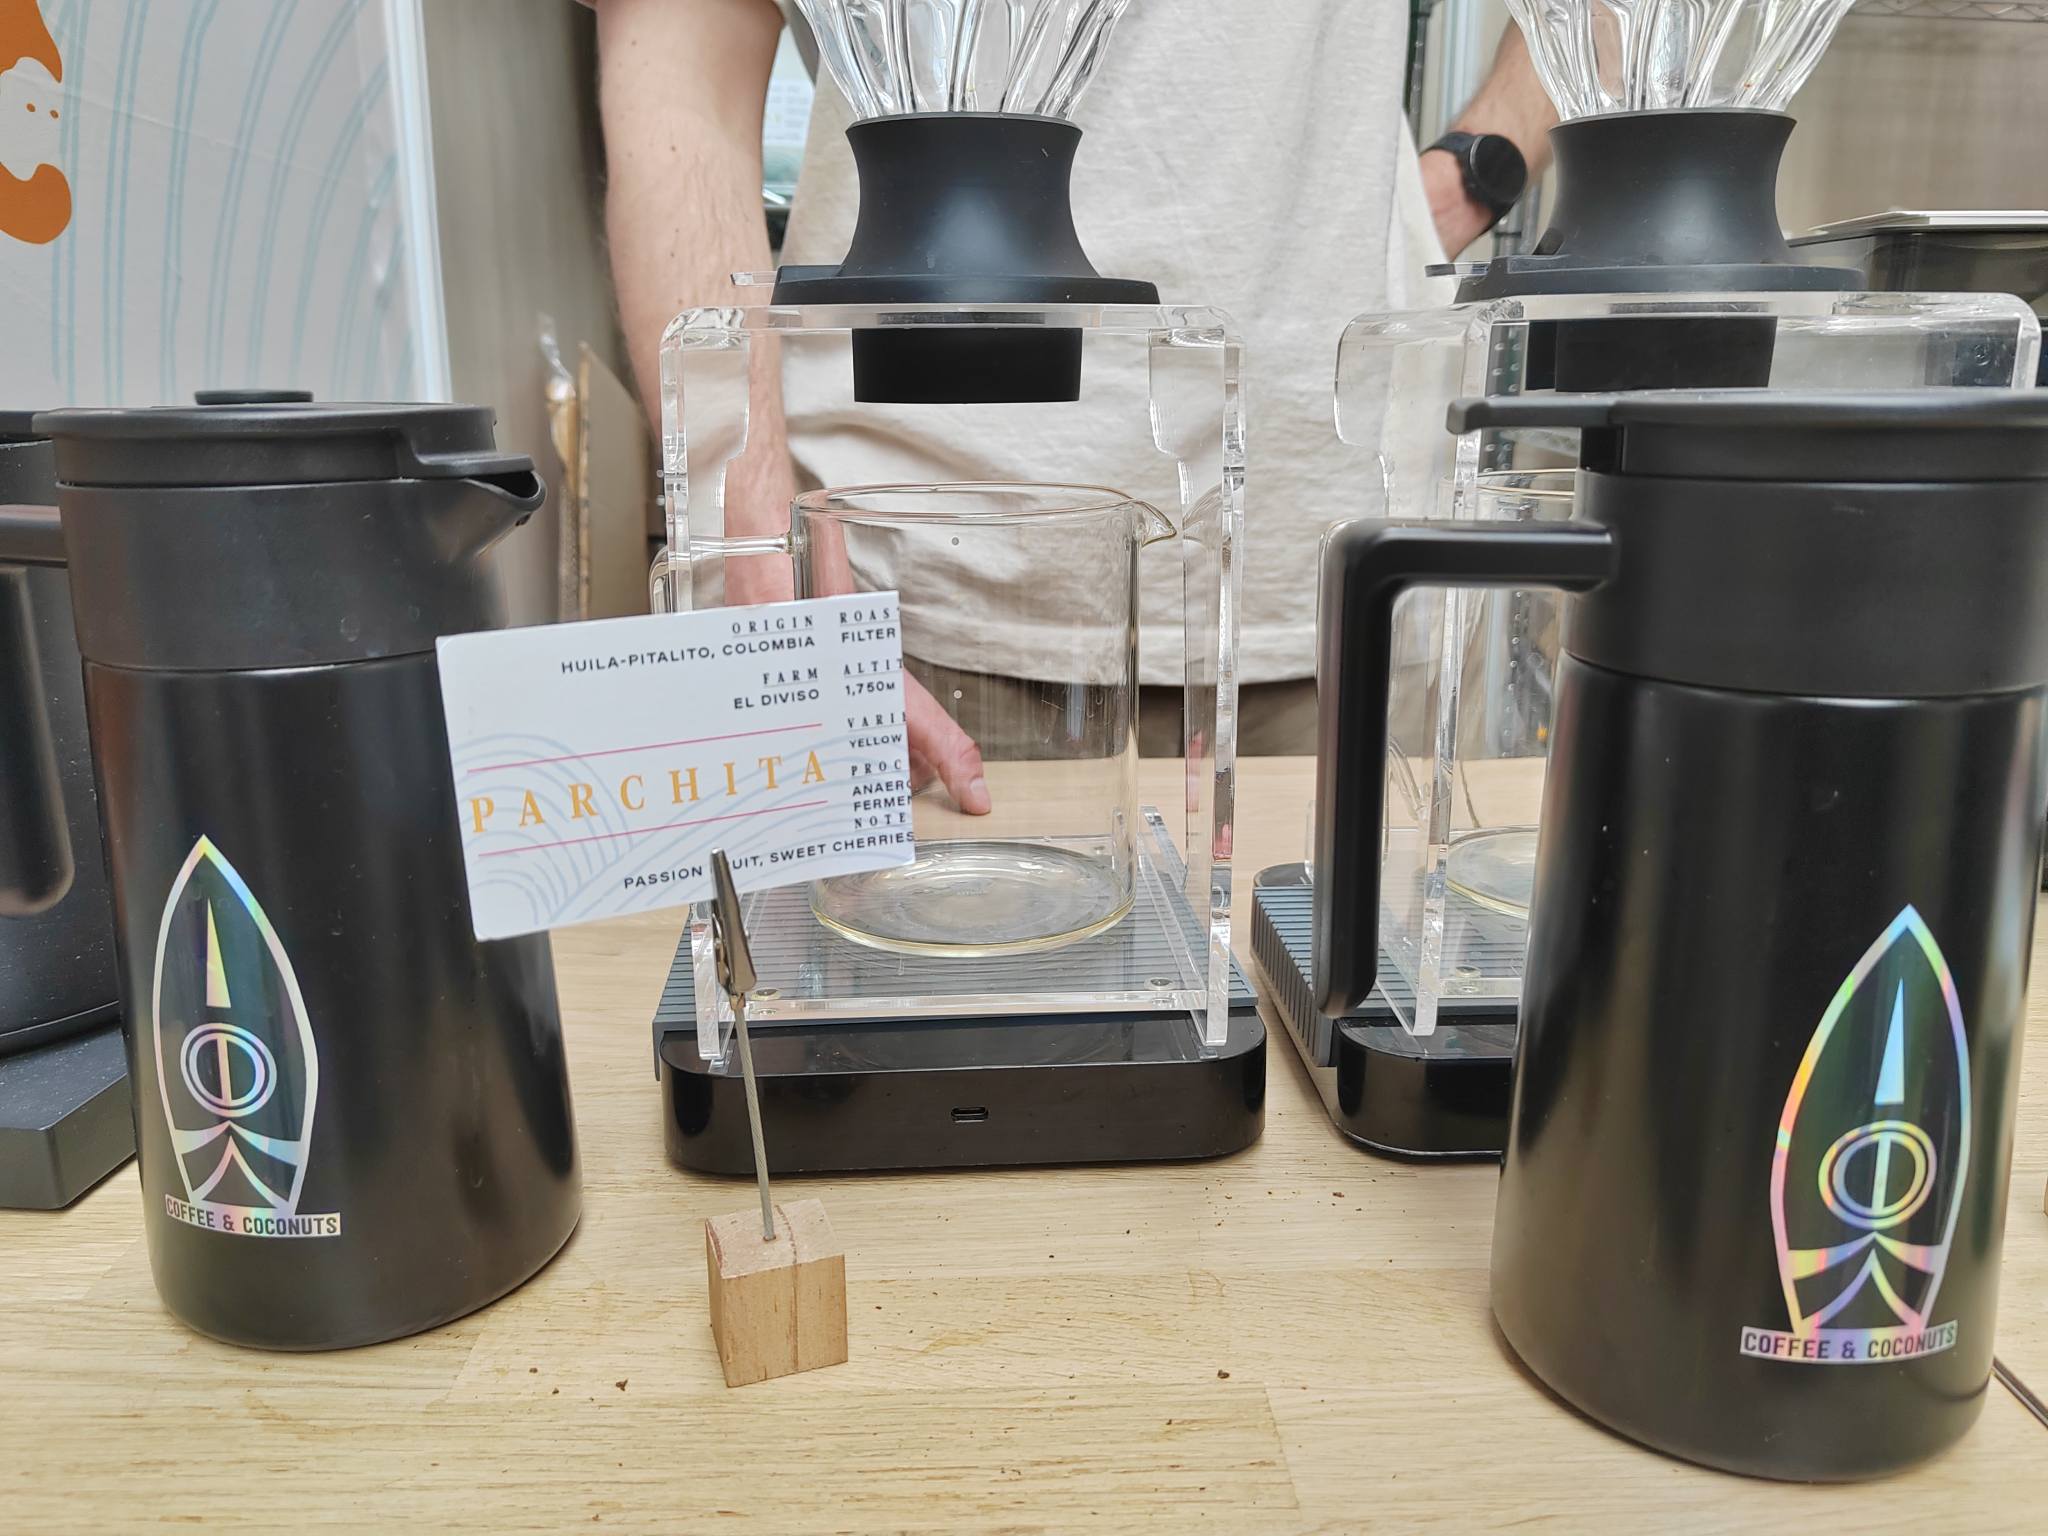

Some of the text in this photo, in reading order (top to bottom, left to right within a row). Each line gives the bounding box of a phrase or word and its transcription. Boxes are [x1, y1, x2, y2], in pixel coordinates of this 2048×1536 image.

[732, 615, 813, 634] ORIGIN
[840, 606, 899, 624] ROAS
[841, 627, 896, 643] FILTER
[561, 636, 815, 674] HUILA-PITALITO, COLOMBIA
[763, 668, 818, 685] FARM
[734, 688, 820, 710] EL DIVISO
[849, 733, 902, 748] YELLOW
[851, 759, 902, 776] PROC
[470, 751, 826, 833] PARCHITA
[854, 812, 906, 829] NOTE
[623, 866, 703, 889] PASSION
[769, 843, 827, 863] SWEET
[832, 831, 914, 852] CHERRIES
[166, 1197, 338, 1235] COFFEE & COCONUTS
[1743, 1325, 1955, 1359] COFFEE & COCONUTS
